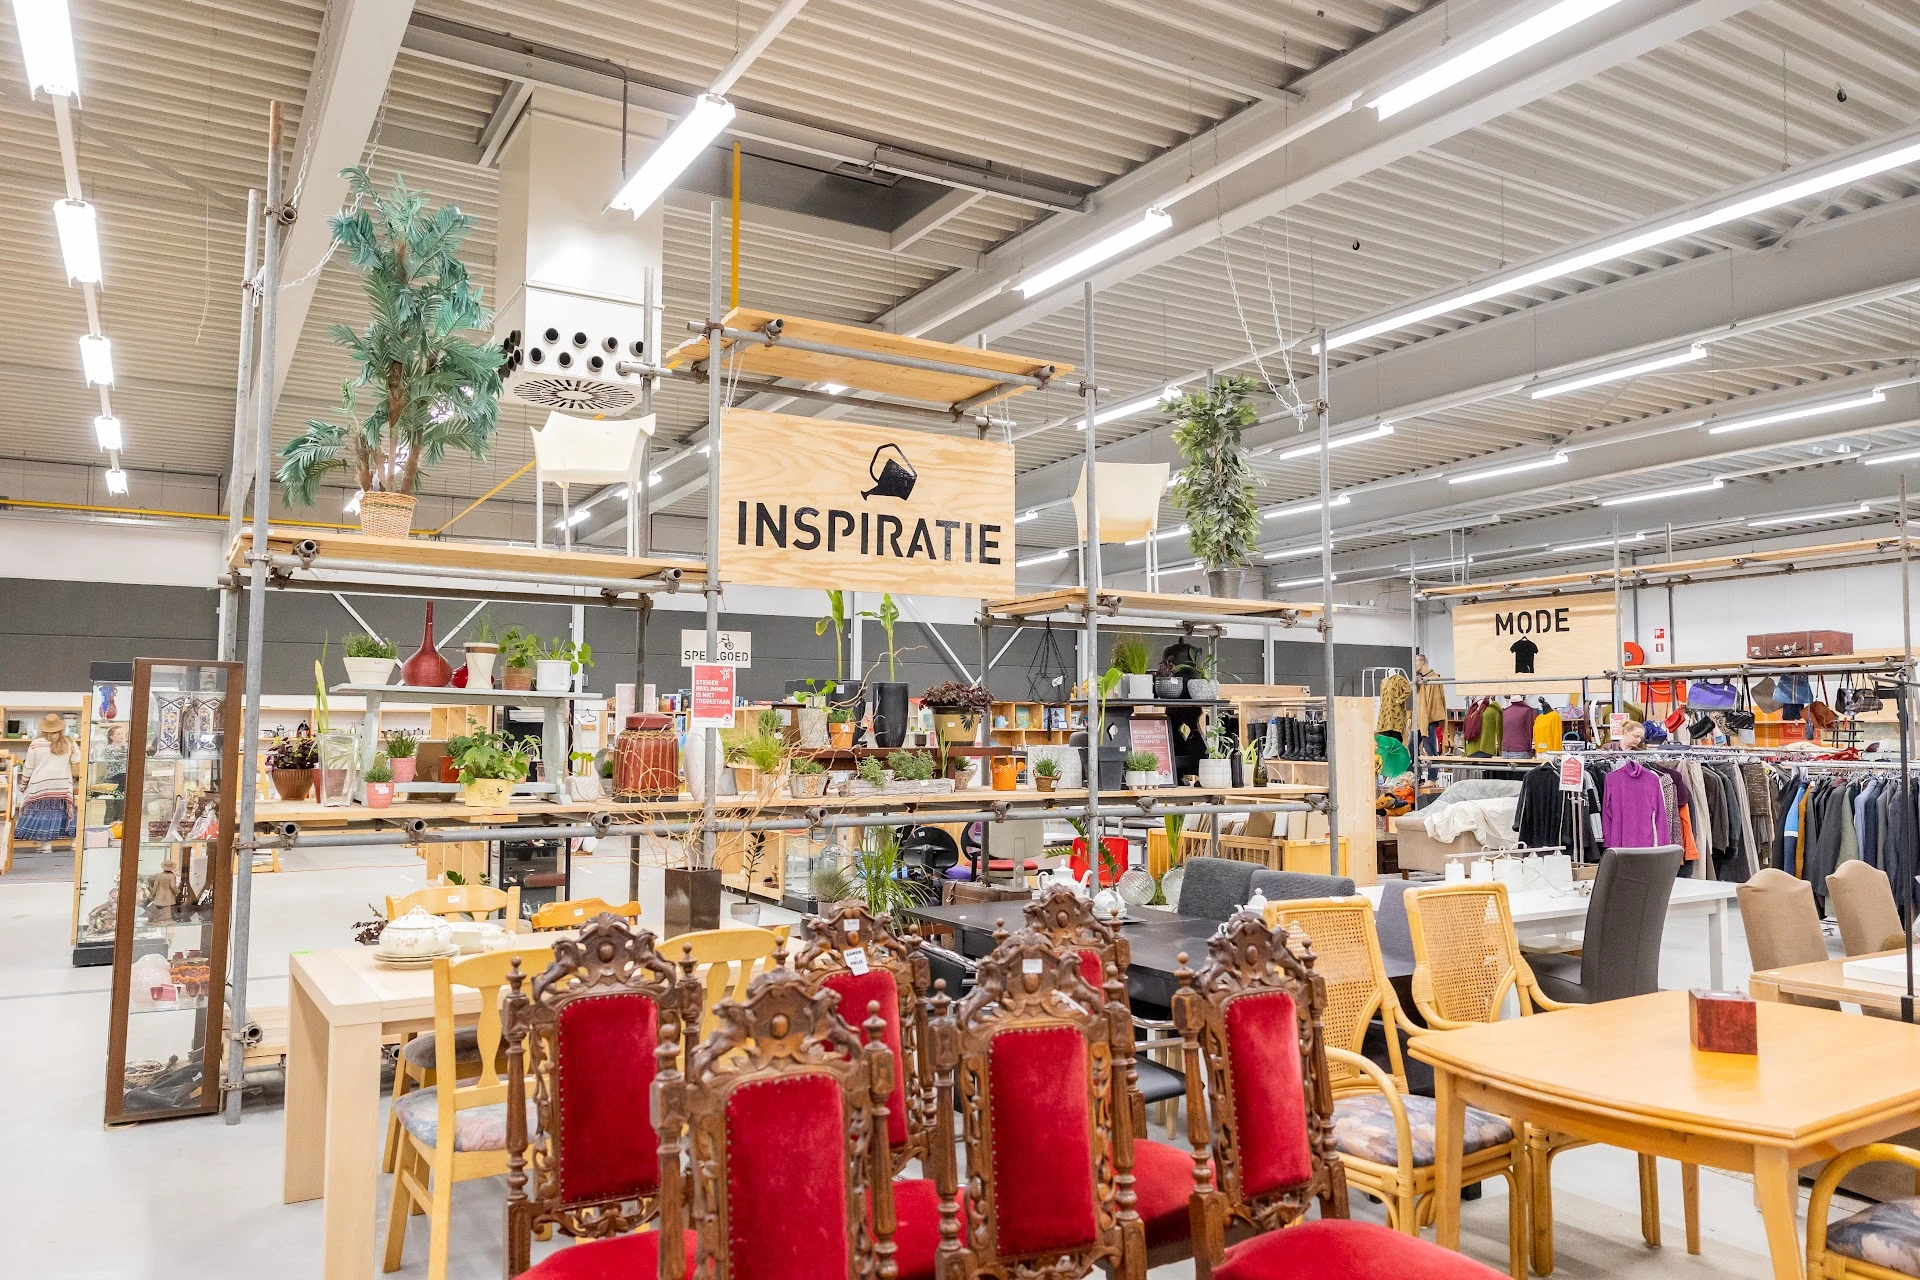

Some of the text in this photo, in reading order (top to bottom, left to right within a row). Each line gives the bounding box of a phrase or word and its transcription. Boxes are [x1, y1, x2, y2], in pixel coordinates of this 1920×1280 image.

[738, 501, 1001, 565] INSPIRATIE
[1495, 607, 1570, 636] MODE
[684, 650, 749, 662] SPEGOED
[695, 685, 729, 693] BEKLIMMEN
